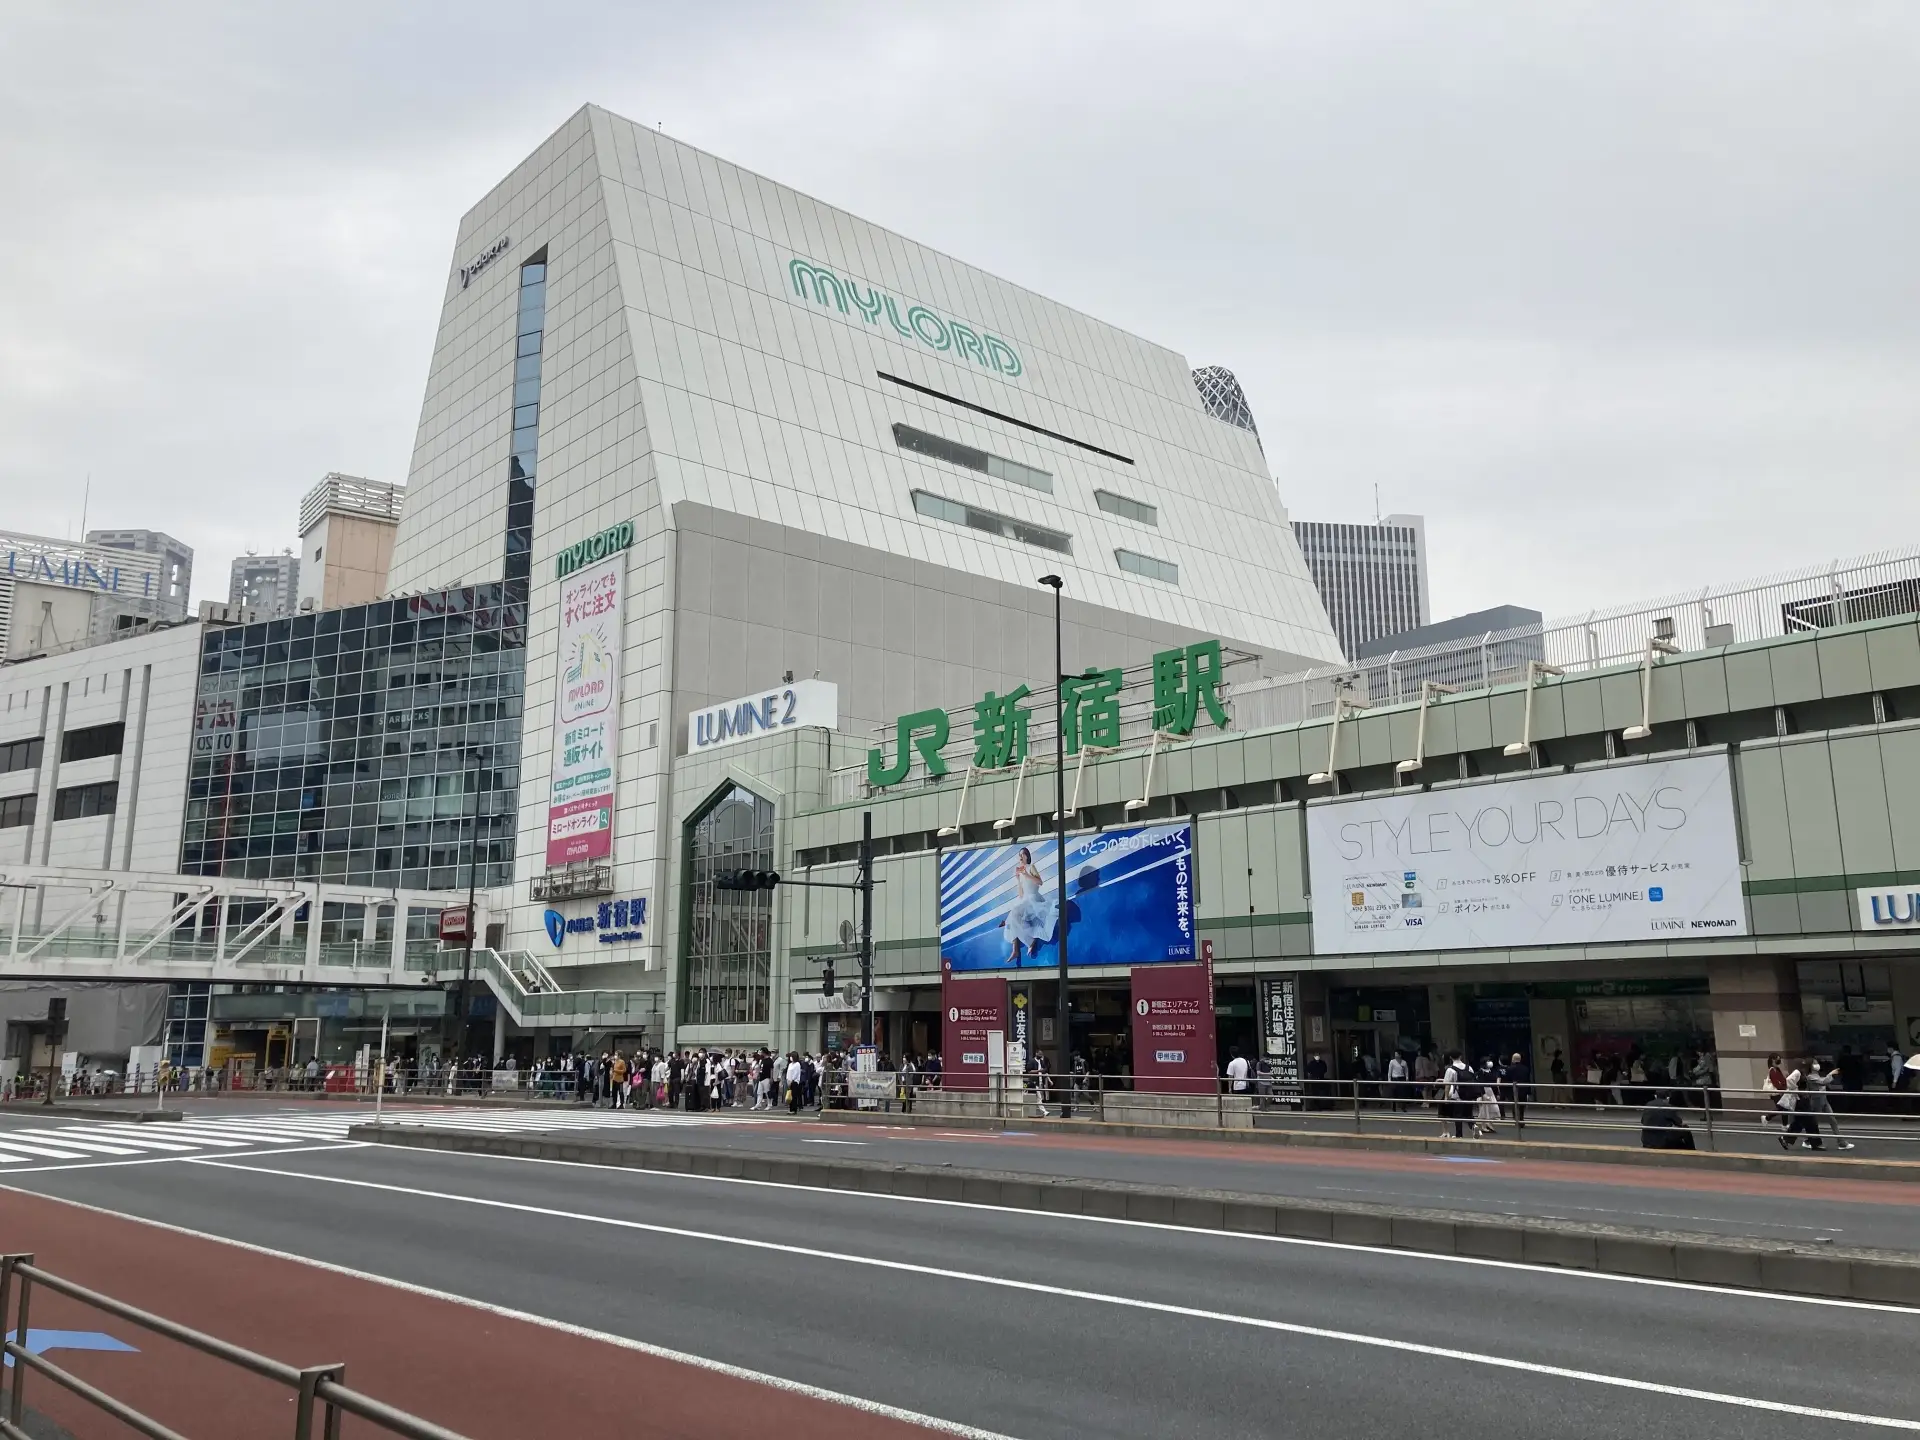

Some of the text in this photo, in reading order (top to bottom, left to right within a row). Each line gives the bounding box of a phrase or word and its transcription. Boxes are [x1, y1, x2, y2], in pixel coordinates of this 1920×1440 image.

[789, 259, 1023, 377] MYLORD
[555, 520, 634, 578] MYLORD
[566, 572, 617, 604] オンラインでも
[565, 589, 616, 628] すぐに注文
[568, 679, 605, 703] MYLORD
[379, 710, 430, 726] SARBUCKS
[696, 689, 796, 746] LUMINE 2
[563, 740, 604, 767] 通販サイト
[552, 814, 599, 834] ミロードオンライン
[1340, 787, 1687, 860] STYLE YOUR DAYS
[1494, 872, 1536, 884] 5%OFF
[1605, 862, 1670, 877] 優待サービス
[597, 897, 647, 930] 新宿駅
[1406, 918, 1423, 926] VISA
[1454, 903, 1488, 914] ポイント
[1870, 893, 1920, 925] LU
[1168, 946, 1191, 956] LUMINE
[1151, 1000, 1199, 1008] 新宿区エリアマップ
[1271, 981, 1284, 1035] 三角広場
[1282, 981, 1296, 1056] 新宿住友ビル
